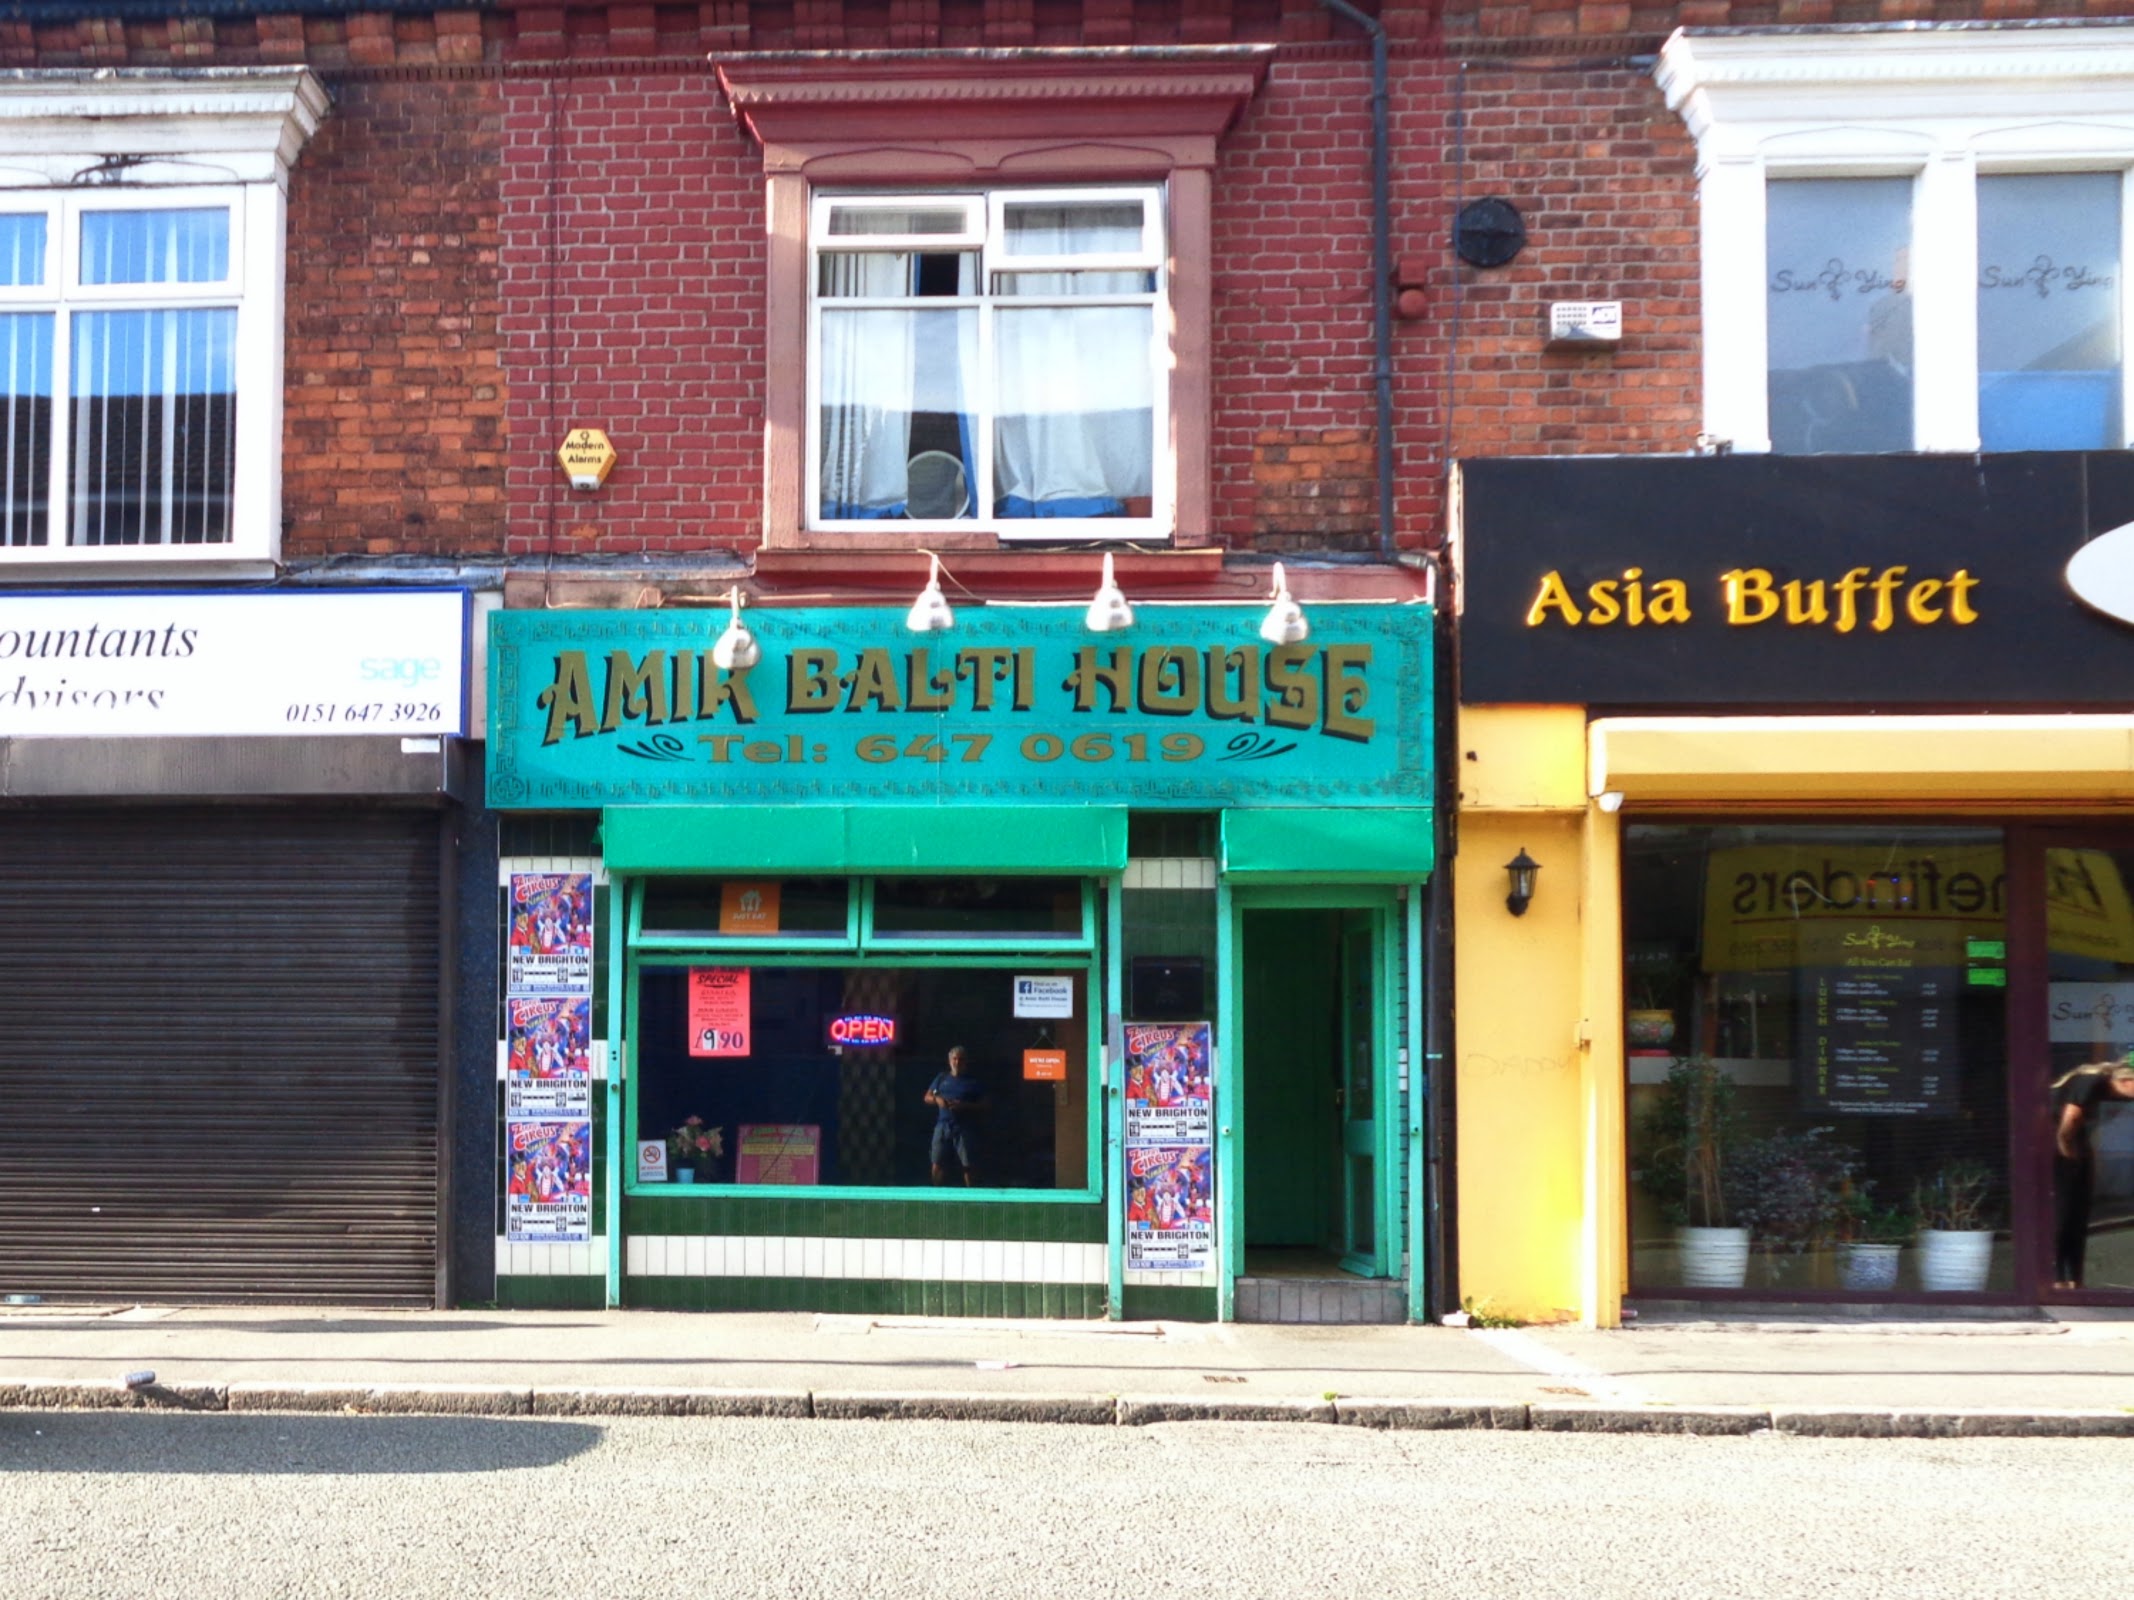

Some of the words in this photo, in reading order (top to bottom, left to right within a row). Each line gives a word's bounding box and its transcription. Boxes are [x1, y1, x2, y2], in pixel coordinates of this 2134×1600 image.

[566, 441, 604, 450] Modern
[568, 454, 601, 463] Alarms
[1527, 567, 1691, 626] Asia
[1720, 566, 1980, 632] Buffet
[359, 655, 441, 688] sage
[536, 649, 761, 747] AMIR
[785, 647, 1036, 714] BALTI
[1062, 643, 1376, 744] HOUSE
[286, 702, 337, 723] 0151
[344, 702, 383, 723] 647
[389, 702, 442, 723] 3926
[697, 734, 828, 764] Tel:
[856, 734, 993, 763] 647
[1020, 732, 1206, 763] 0619
[512, 955, 535, 965] NEW
[538, 955, 588, 965] BRIGHTON
[1033, 986, 1067, 995] Facebook
[513, 1002, 557, 1027] CIRCUS
[831, 1018, 894, 1041] OPEN
[1129, 1030, 1175, 1054] CIRCUS
[510, 1080, 533, 1089] NEW
[536, 1080, 587, 1089] BRIGHTON
[1128, 1108, 1152, 1118] NEW
[1155, 1107, 1208, 1117] BRIGHTON
[513, 1126, 557, 1151] CIRCUS
[1131, 1153, 1178, 1177] CIRCUS
[511, 1204, 533, 1213] NEW
[536, 1204, 587, 1213] BRIGHTON
[1130, 1231, 1154, 1240] NEW
[1157, 1231, 1209, 1240] BRIGHTON
